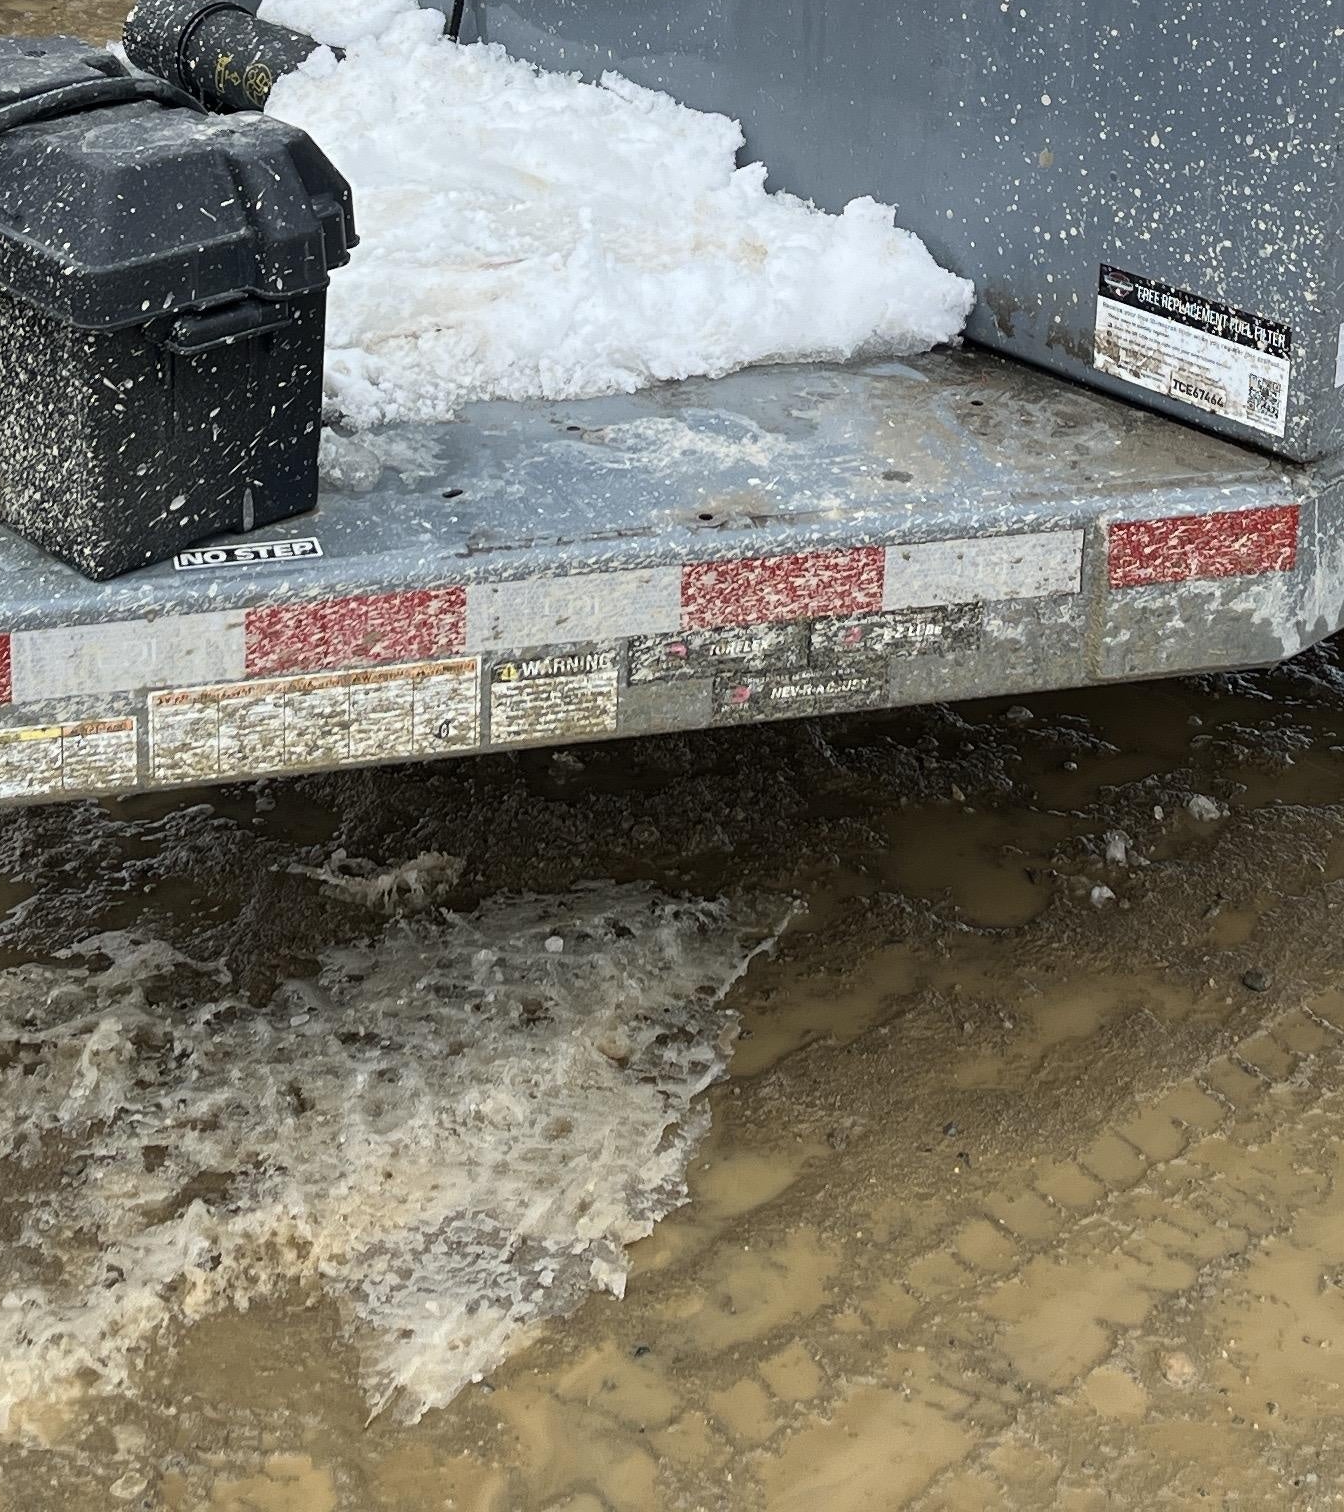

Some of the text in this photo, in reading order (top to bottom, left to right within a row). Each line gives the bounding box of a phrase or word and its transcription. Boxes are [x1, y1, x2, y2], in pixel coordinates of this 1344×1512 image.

[1137, 285, 1161, 308] FREE
[1161, 294, 1228, 328] REPLACEMENT
[1229, 316, 1254, 339] FUEL
[1254, 325, 1287, 350] FILTER
[1172, 378, 1225, 408] TCE67464
[180, 541, 314, 566] NO STEP
[521, 651, 618, 677] WARNING
